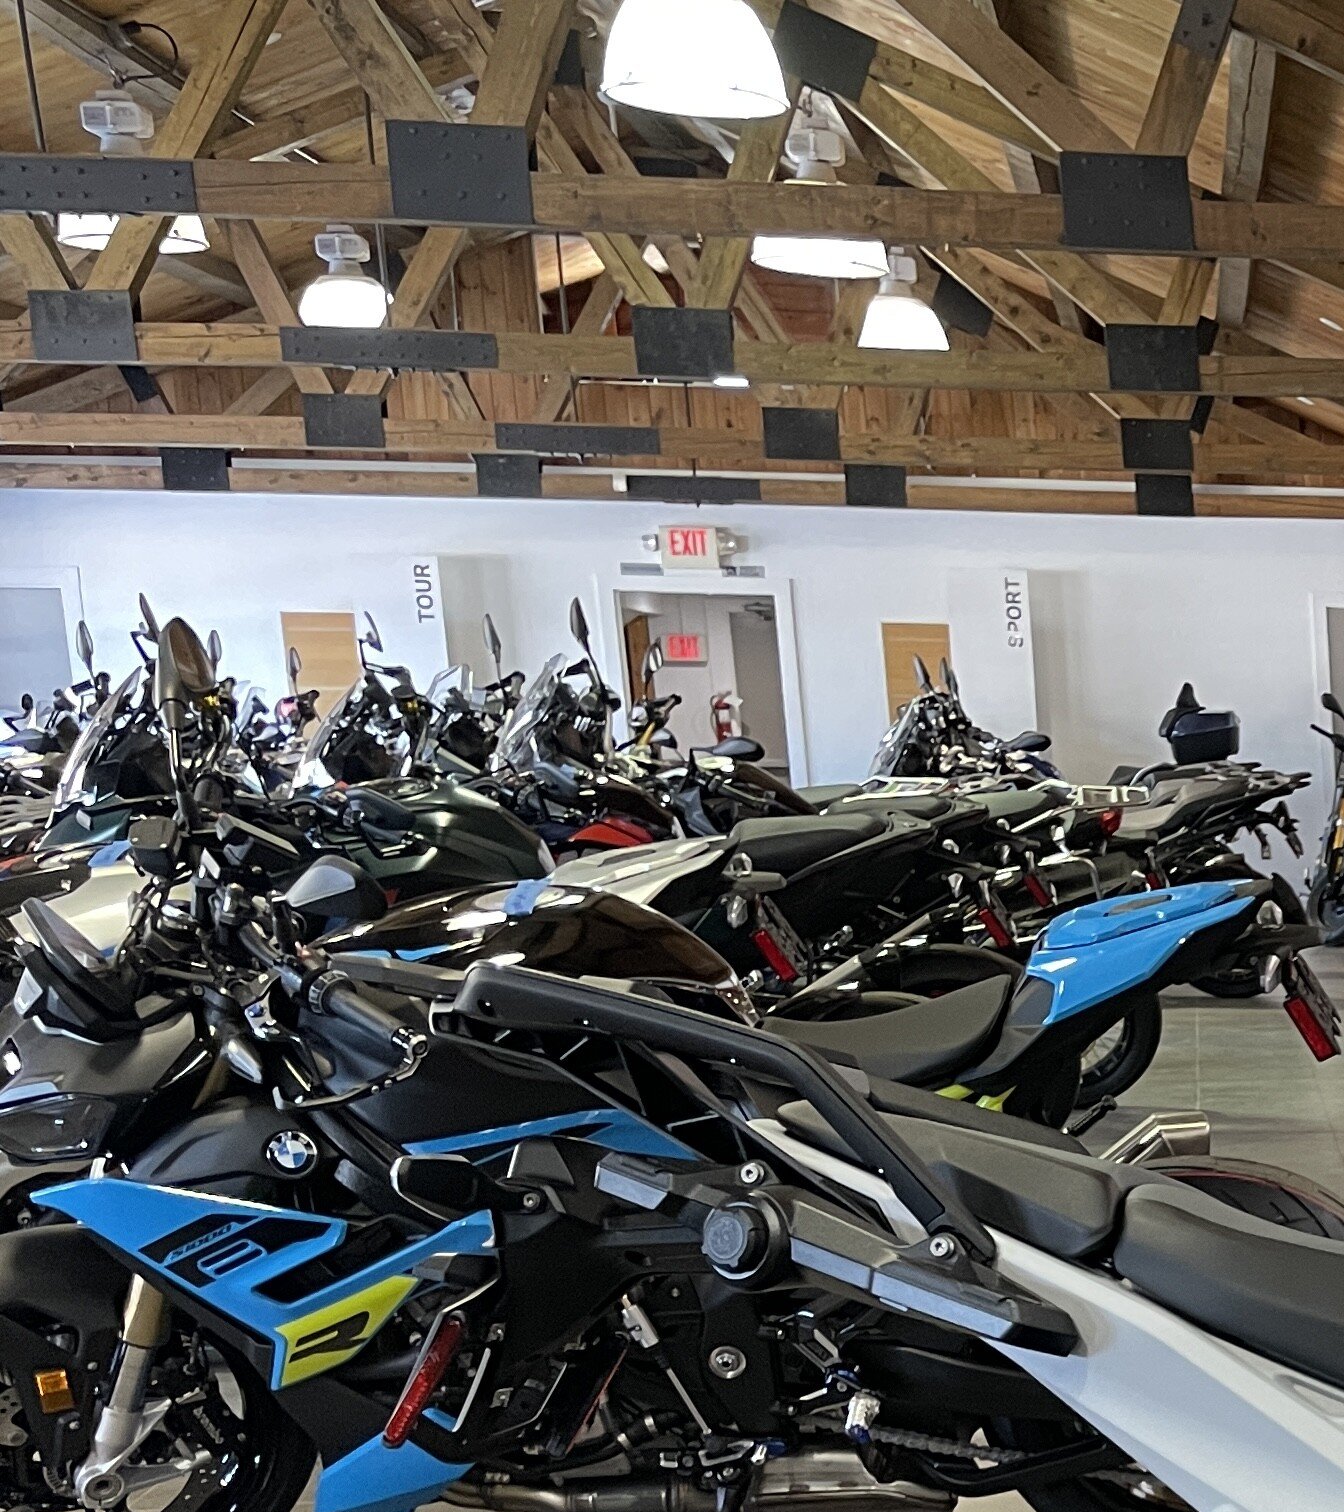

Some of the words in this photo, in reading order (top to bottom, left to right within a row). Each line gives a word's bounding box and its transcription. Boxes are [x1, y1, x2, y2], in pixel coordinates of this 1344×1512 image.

[669, 529, 706, 557] EXIT
[413, 564, 436, 624] TOUR
[1004, 576, 1024, 648] SPORT
[668, 635, 699, 659] EXIT
[288, 1310, 371, 1364] R
